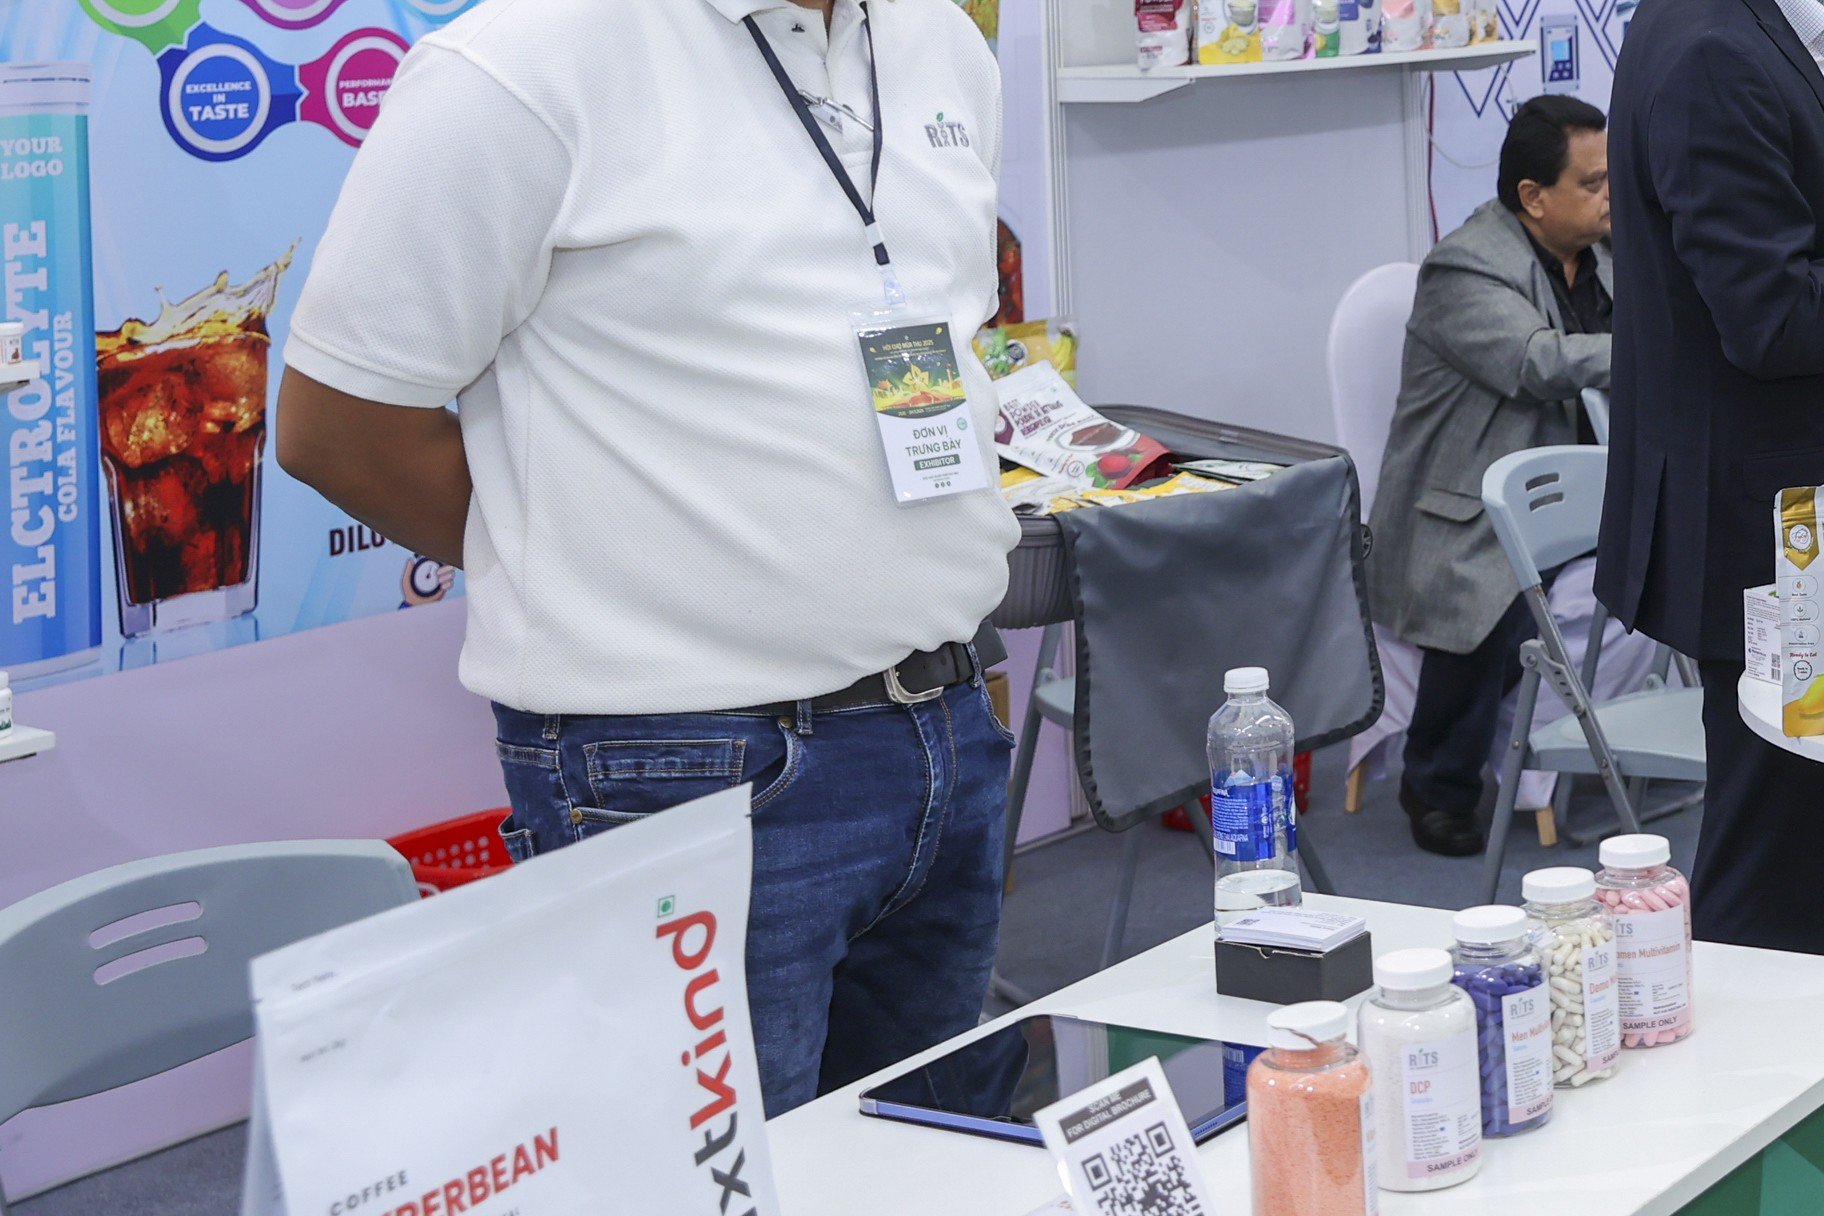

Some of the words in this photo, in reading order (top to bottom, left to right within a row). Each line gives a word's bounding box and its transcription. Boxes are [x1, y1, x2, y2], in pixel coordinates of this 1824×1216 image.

[185, 81, 251, 94] EXCELLENCE
[213, 93, 226, 102] IN
[189, 103, 249, 122] TASTE
[1, 136, 63, 156] YOUR
[1, 159, 63, 179] LOGO
[54, 311, 74, 444] FLAVOUR
[913, 426, 936, 440] ĐƠN
[937, 424, 948, 438] VỊ
[905, 442, 941, 457] TRƯNG
[942, 438, 962, 451] BÀY
[919, 456, 956, 470] EXHIBITOR
[57, 451, 79, 522] COLA
[329, 525, 386, 556] DILU
[1616, 950, 1637, 959] omen
[1639, 942, 1680, 959] Multivitamin
[1622, 1020, 1656, 1030] SAMPLE
[1658, 1015, 1677, 1027] ONLY
[1512, 1031, 1528, 1042] Men
[656, 910, 757, 1216] xtkind
[1410, 1080, 1431, 1094] DCP
[1067, 1124, 1084, 1138] FOR
[1083, 1110, 1113, 1129] DIGITAL
[1110, 1088, 1151, 1115] BROCHURE
[1088, 1094, 1111, 1113] SCAN
[381, 1126, 559, 1216] ERBEAN
[1427, 1157, 1462, 1173] SAMPLE
[329, 1170, 408, 1216] COFFEE
